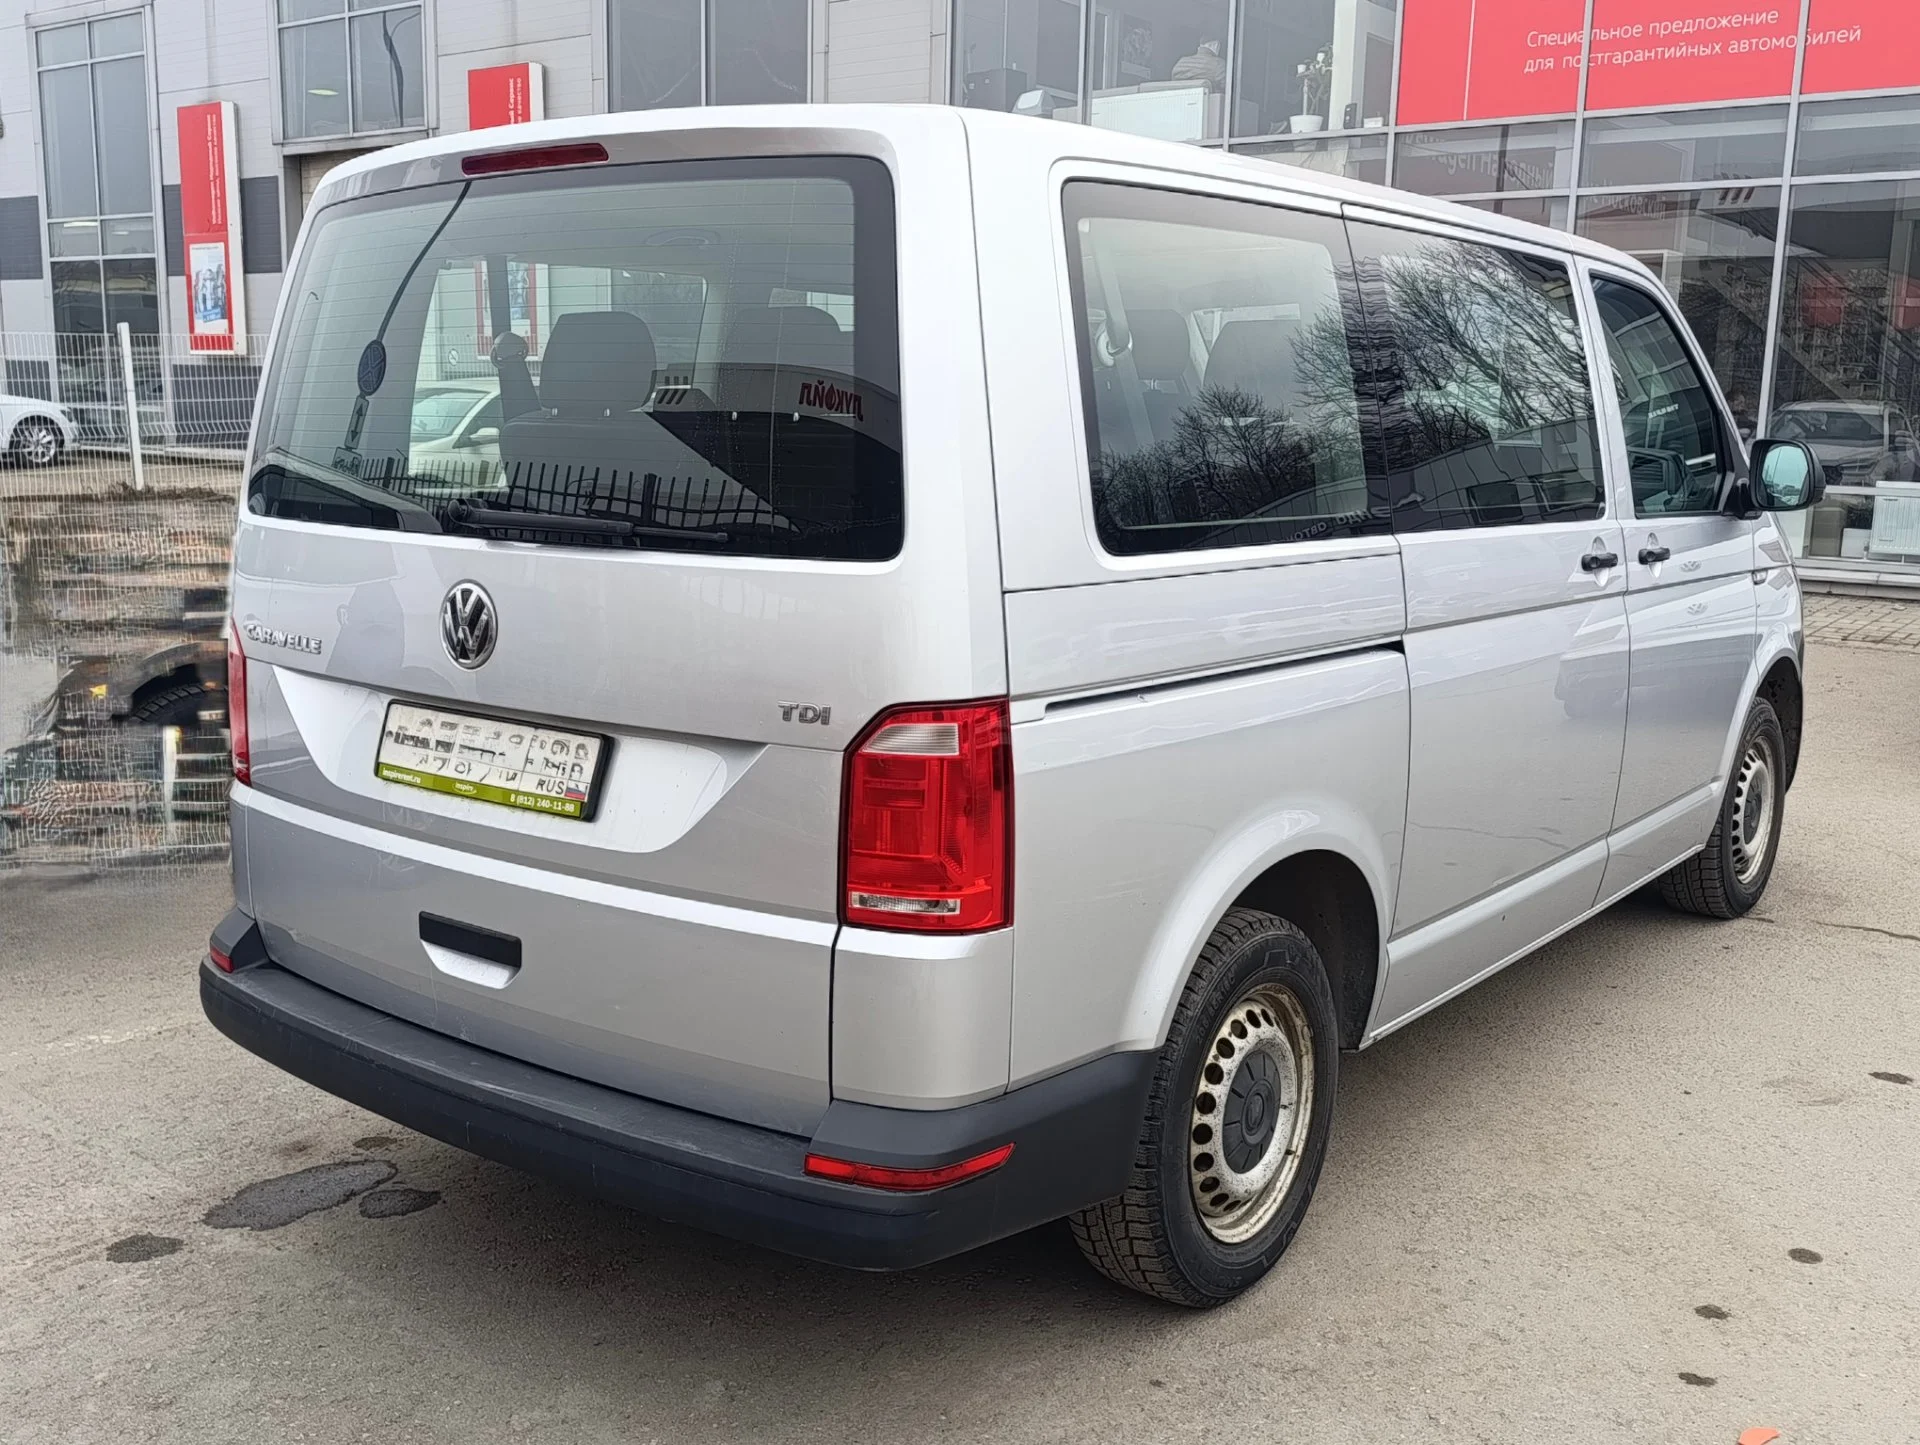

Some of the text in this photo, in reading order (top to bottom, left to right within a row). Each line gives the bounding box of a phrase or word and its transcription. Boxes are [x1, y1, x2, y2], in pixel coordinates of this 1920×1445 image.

[1527, 10, 1779, 47] Специальное предложение
[1523, 57, 1554, 74] для
[1562, 41, 1722, 69] постгарантийных
[778, 700, 831, 726] TDI
[536, 778, 566, 795] RUS
[510, 793, 516, 803] 8
[517, 795, 535, 808] (812)
